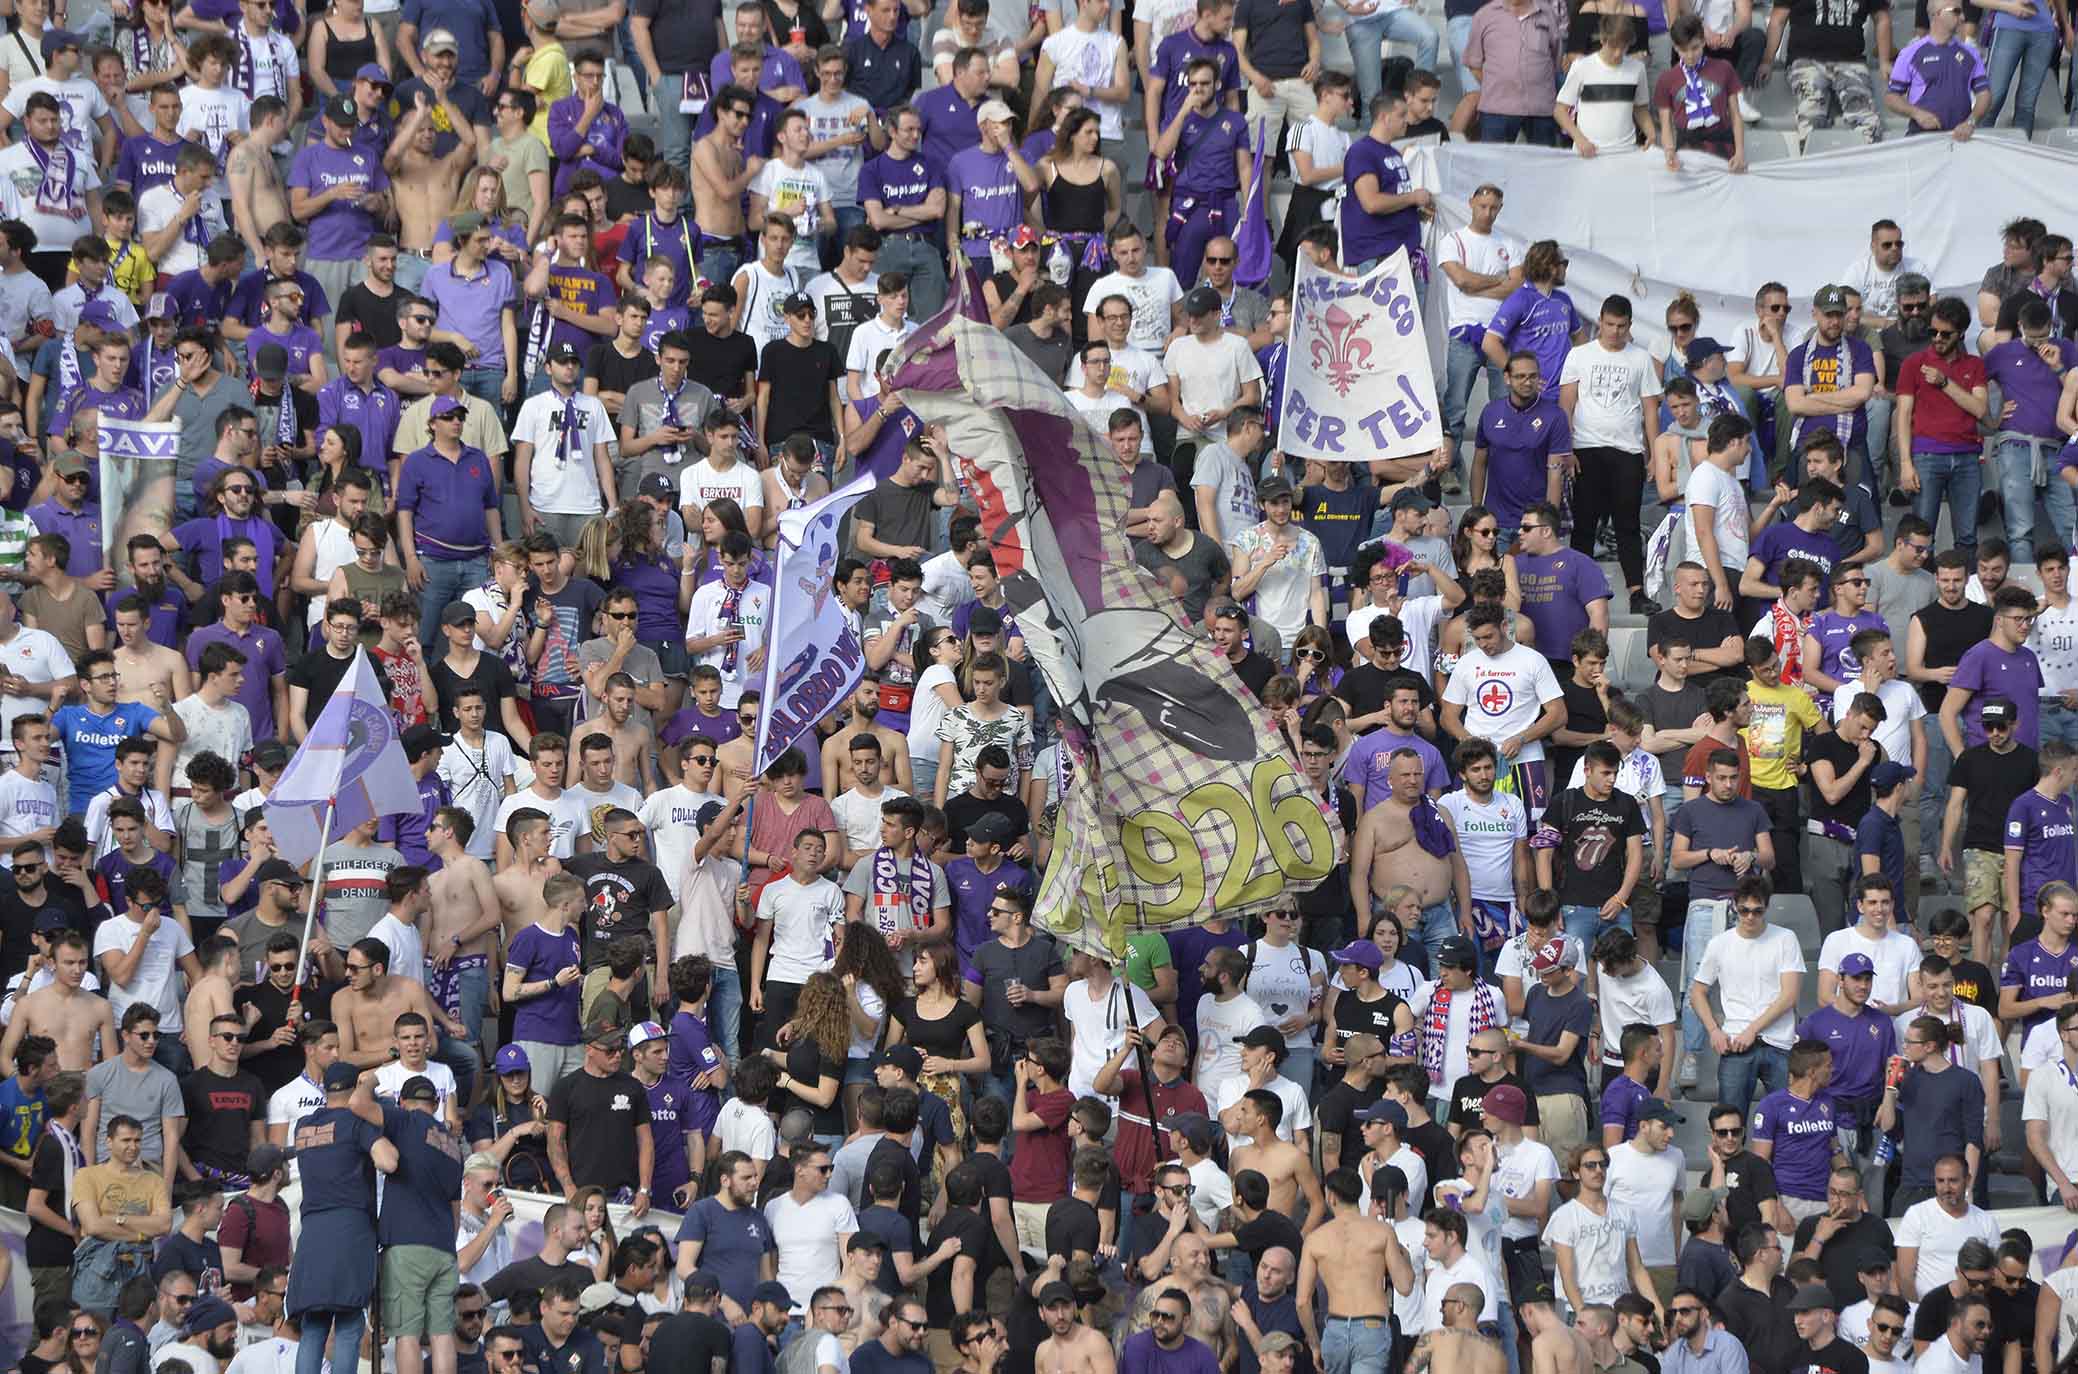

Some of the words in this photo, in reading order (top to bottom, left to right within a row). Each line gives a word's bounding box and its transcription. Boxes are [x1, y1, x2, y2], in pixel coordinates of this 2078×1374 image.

[141, 160, 177, 176] follet
[1286, 389, 1346, 452] PER
[1358, 374, 1432, 449] TE!
[703, 487, 740, 498] BRKLYN
[671, 807, 698, 823] COLLE
[1464, 821, 1513, 832] folletto
[2042, 824, 2075, 839] follett
[334, 860, 390, 872] HILFIGER
[341, 888, 380, 898] DENIM
[1788, 1118, 1835, 1135] folletto
